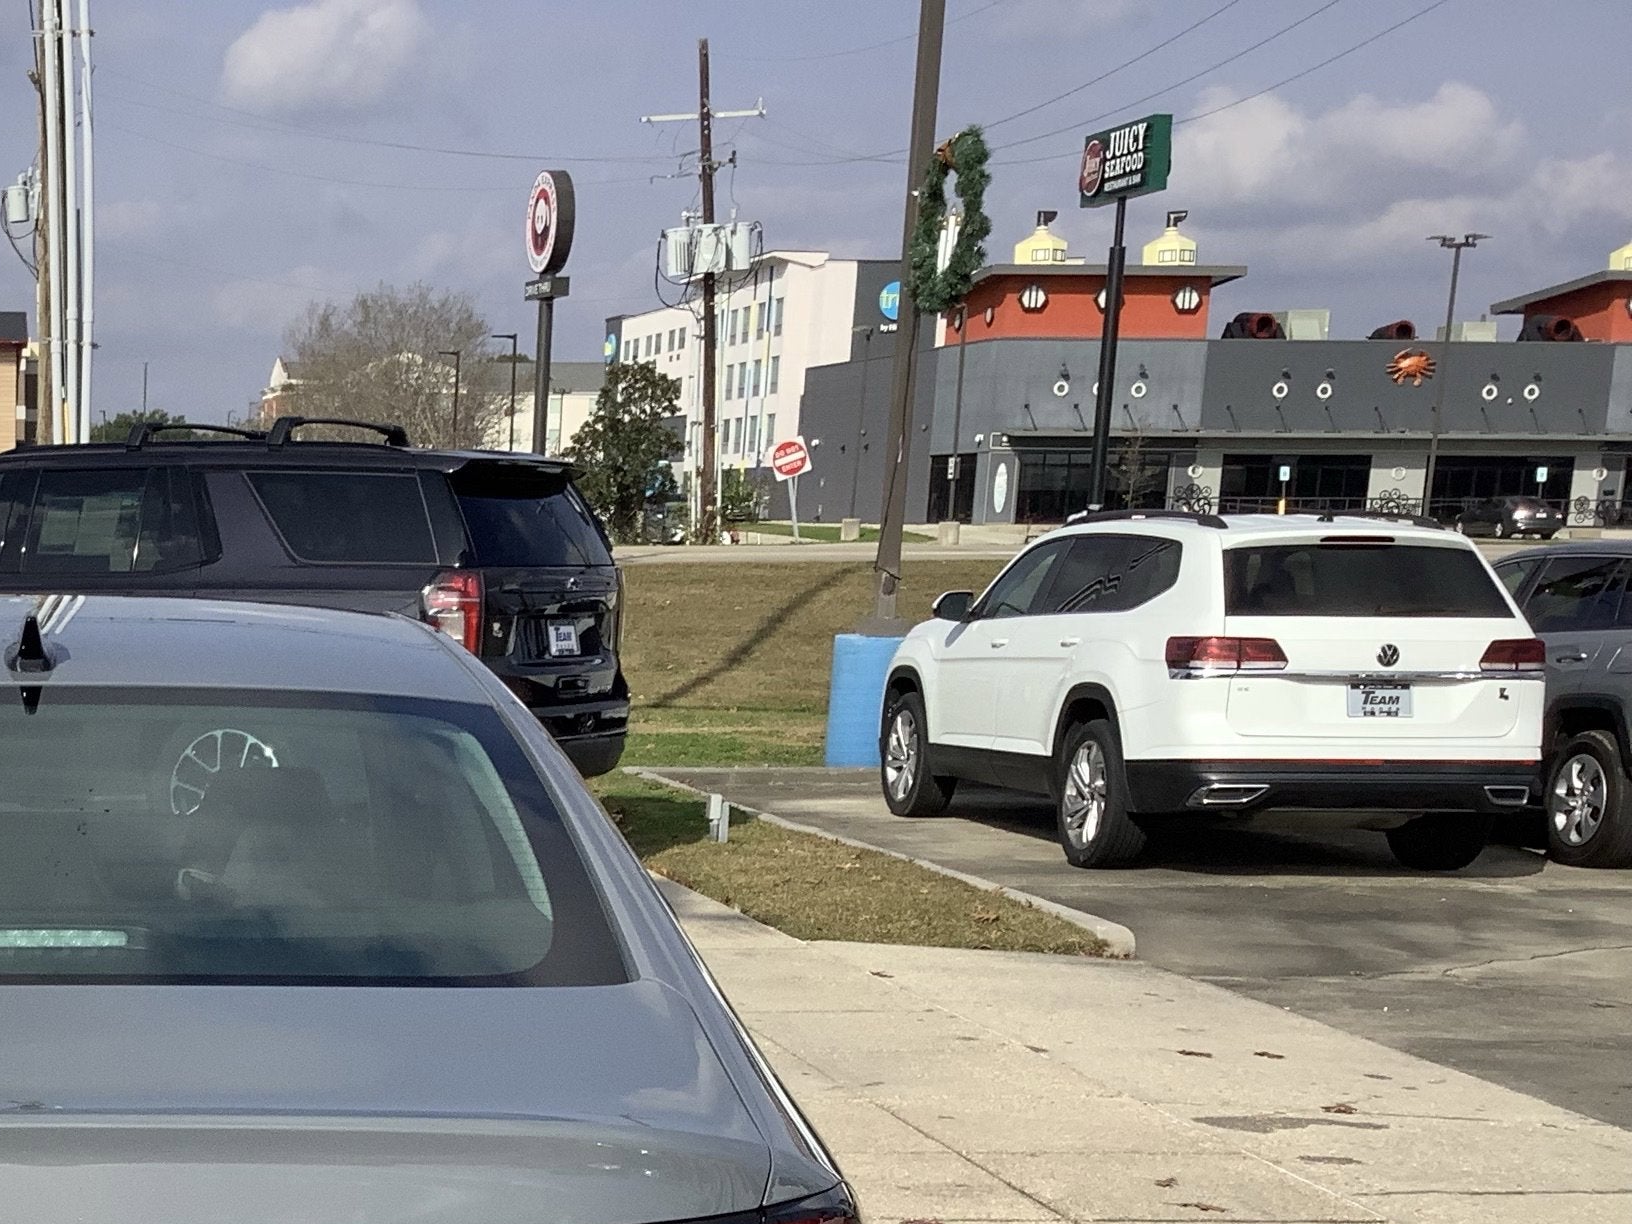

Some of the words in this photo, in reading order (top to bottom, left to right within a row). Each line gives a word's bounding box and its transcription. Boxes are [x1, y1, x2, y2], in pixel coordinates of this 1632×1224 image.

[1106, 122, 1147, 159] JUICY
[1104, 151, 1144, 179] SEAFOOD
[1361, 690, 1400, 705] TEAM
